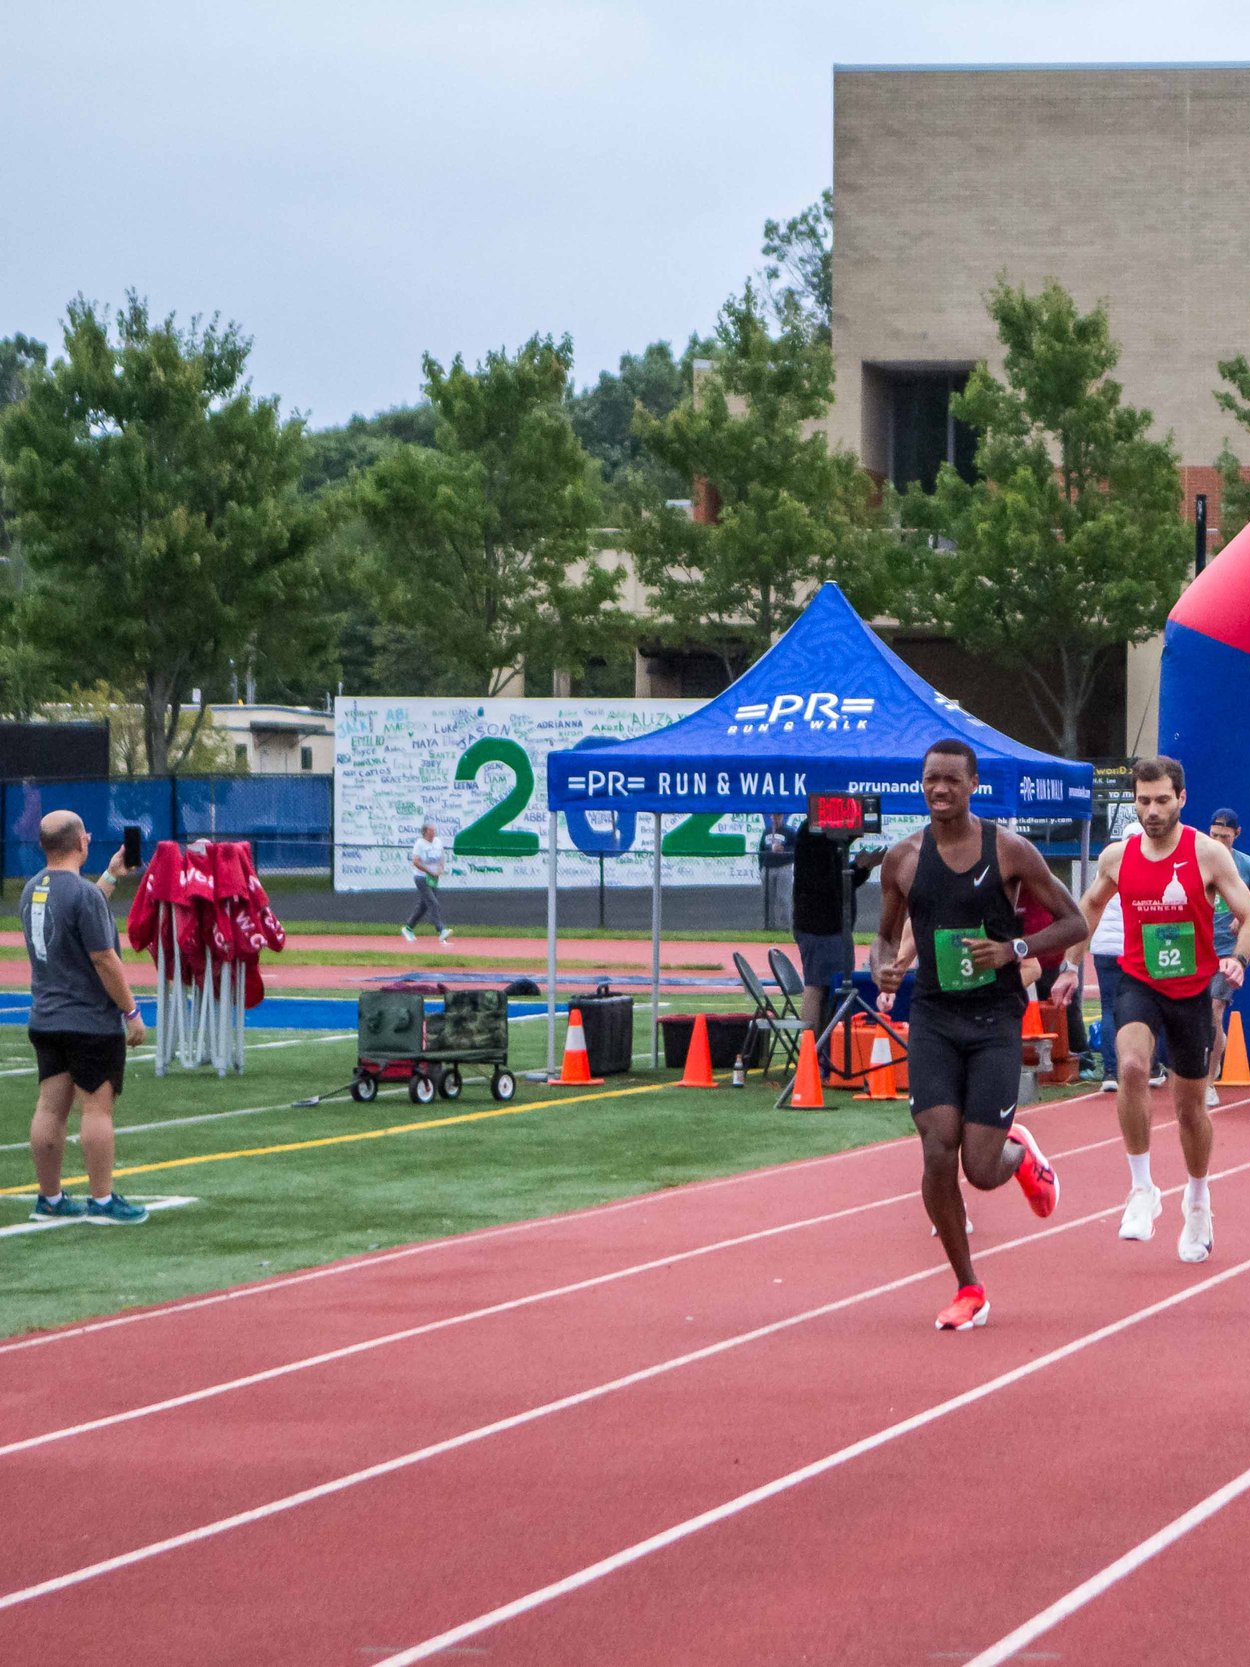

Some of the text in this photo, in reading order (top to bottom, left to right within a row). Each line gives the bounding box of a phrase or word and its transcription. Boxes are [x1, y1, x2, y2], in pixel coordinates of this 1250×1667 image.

[727, 719, 868, 735] RUN & WALK
[658, 772, 707, 795] RUN
[716, 772, 731, 795] &
[740, 772, 807, 795] WALK
[1158, 948, 1181, 967] 52
[960, 958, 974, 977] 3
